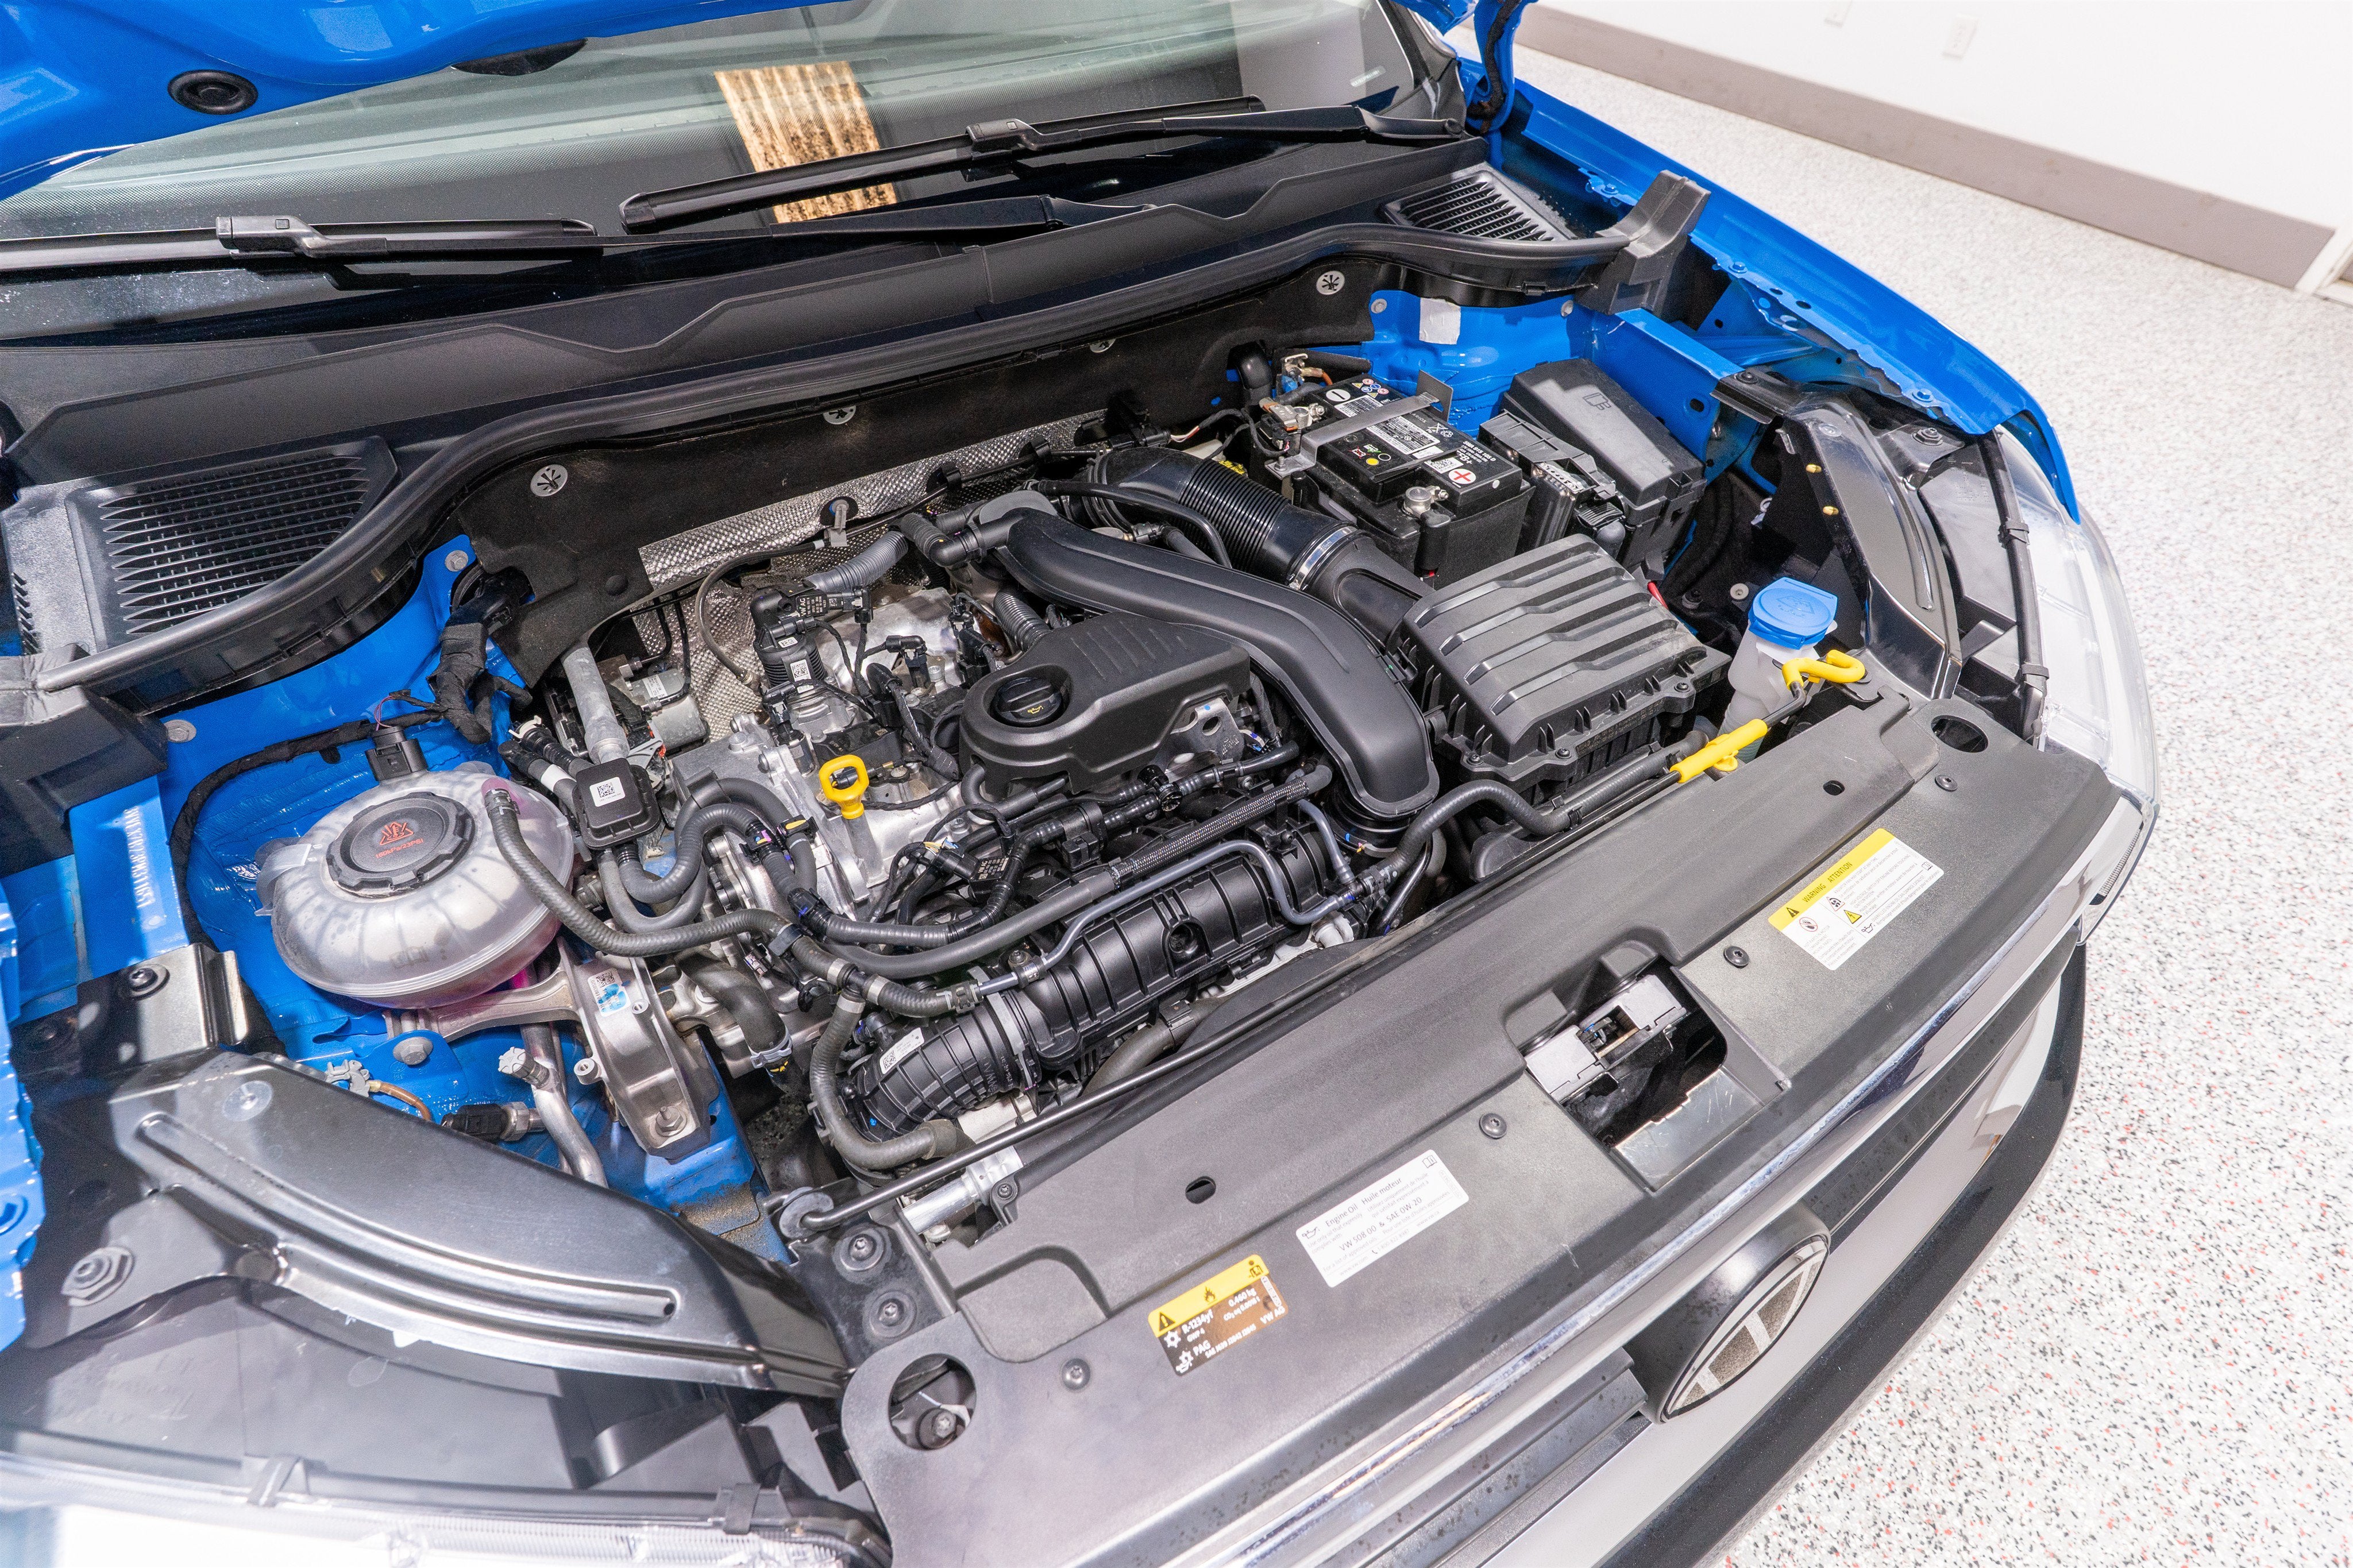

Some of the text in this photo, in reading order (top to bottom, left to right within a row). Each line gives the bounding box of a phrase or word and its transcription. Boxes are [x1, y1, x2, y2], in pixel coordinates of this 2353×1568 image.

[799, 598, 807, 617] VW AG
[375, 838, 424, 859] 160kPa/23PSI
[1802, 861, 1853, 903] WARNING ATTENTION
[1360, 1175, 1403, 1206] Huile moteur
[1383, 1183, 1410, 1203] uniquement
[1325, 1202, 1359, 1229] Engine Oil
[1370, 1210, 1380, 1219] qui
[1378, 1199, 1397, 1213] satisfait
[1307, 1240, 1317, 1248] Use
[1316, 1234, 1328, 1244] only
[1332, 1223, 1343, 1233] that
[1341, 1211, 1363, 1228] expressly
[1338, 1239, 1354, 1252] VW
[1352, 1230, 1367, 1243] 508
[1365, 1224, 1378, 1235] 00
[1378, 1219, 1386, 1227] &
[1385, 1209, 1401, 1223] SAE
[1382, 1225, 1394, 1235] Pour
[1392, 1220, 1402, 1229] une
[1401, 1214, 1411, 1223] liste
[1310, 1232, 1343, 1256] complies with
[1322, 1264, 1330, 1273] For
[1333, 1257, 1343, 1265] list
[1347, 1239, 1370, 1258] approved
[1226, 1290, 1248, 1308] 0.460
[1180, 1308, 1216, 1337] R-1234yf
[1259, 1304, 1286, 1325] VW AG
[1185, 1329, 1202, 1343] GWP
[1191, 1339, 1212, 1356] PAG
